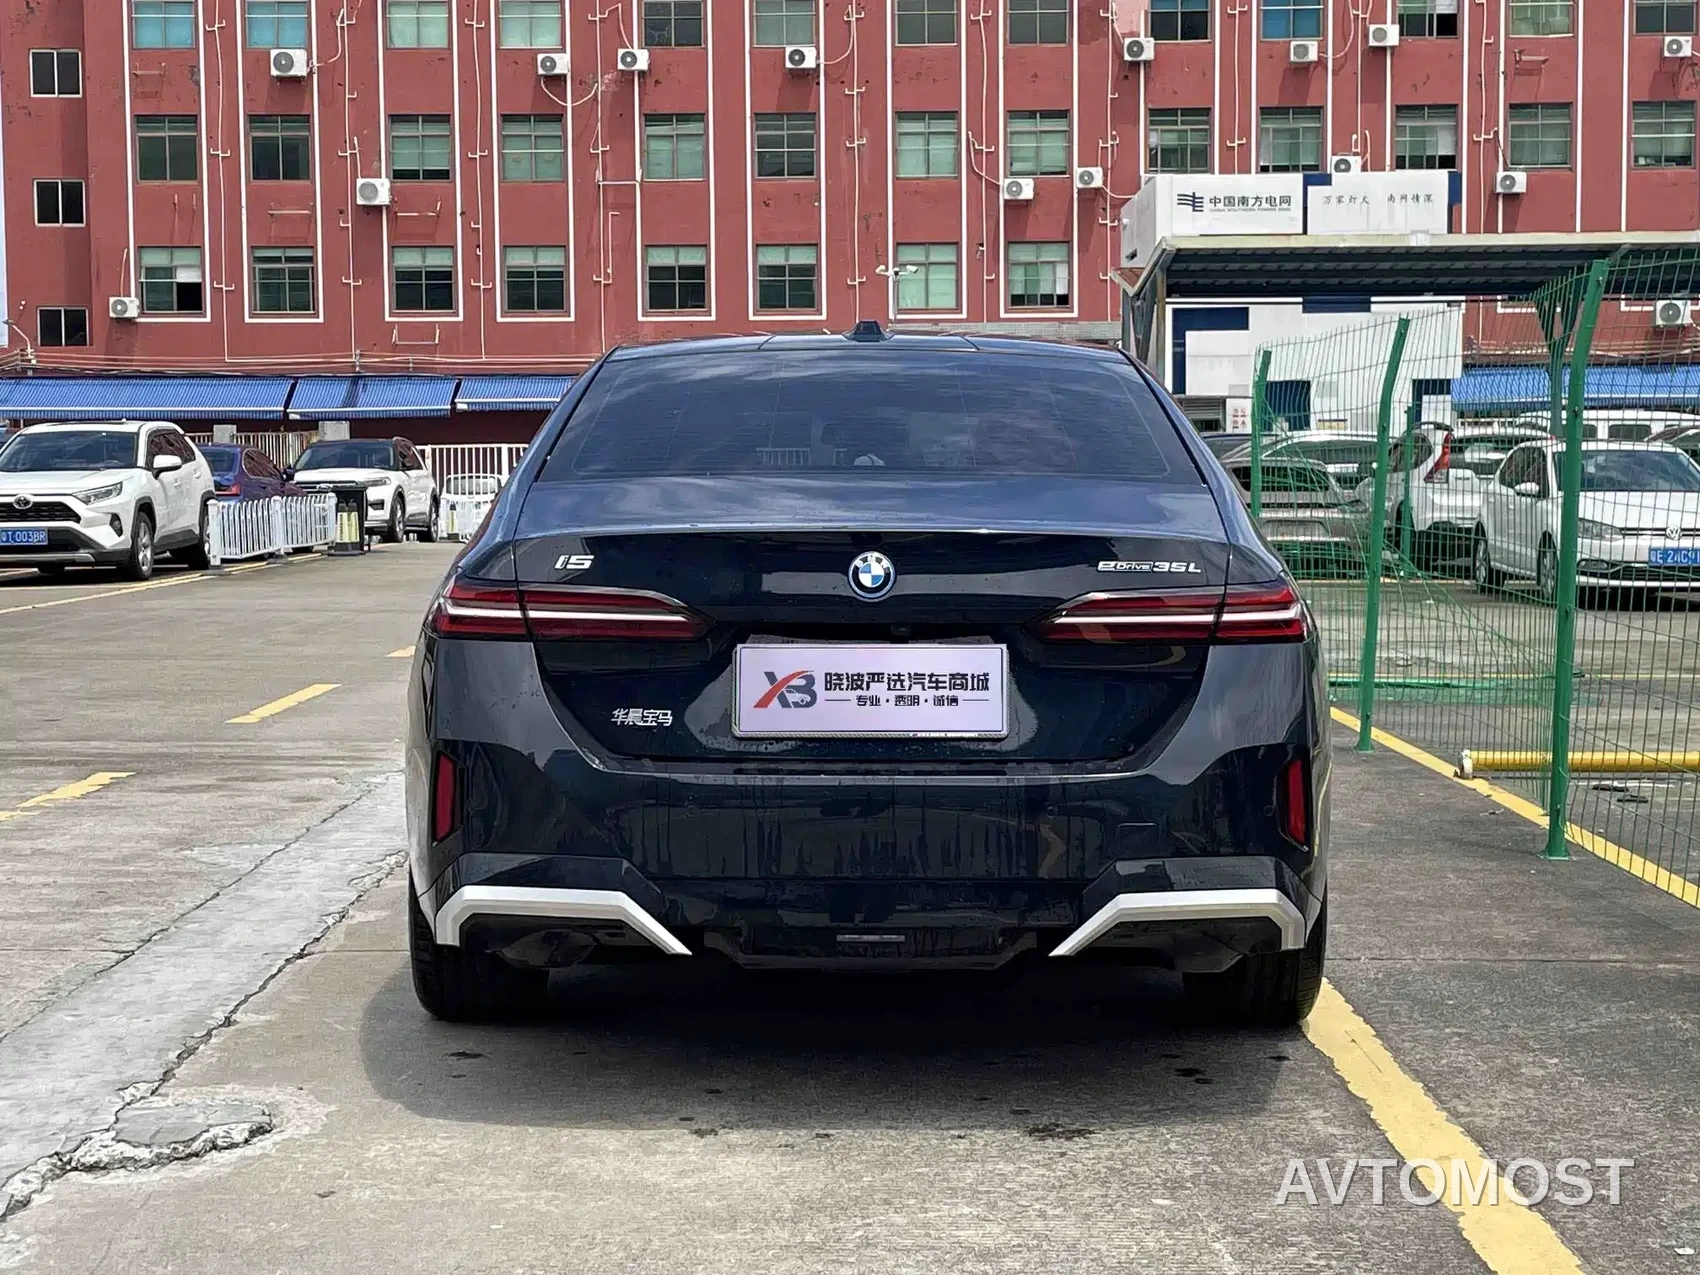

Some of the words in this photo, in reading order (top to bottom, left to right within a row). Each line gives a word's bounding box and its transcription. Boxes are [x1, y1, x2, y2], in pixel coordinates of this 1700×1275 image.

[1209, 195, 1292, 207] 中国南方电网
[554, 554, 595, 569] i5
[853, 553, 891, 569] BMW
[824, 672, 990, 691] 晓波严选汽车商城
[611, 708, 673, 726] 华晨宝马
